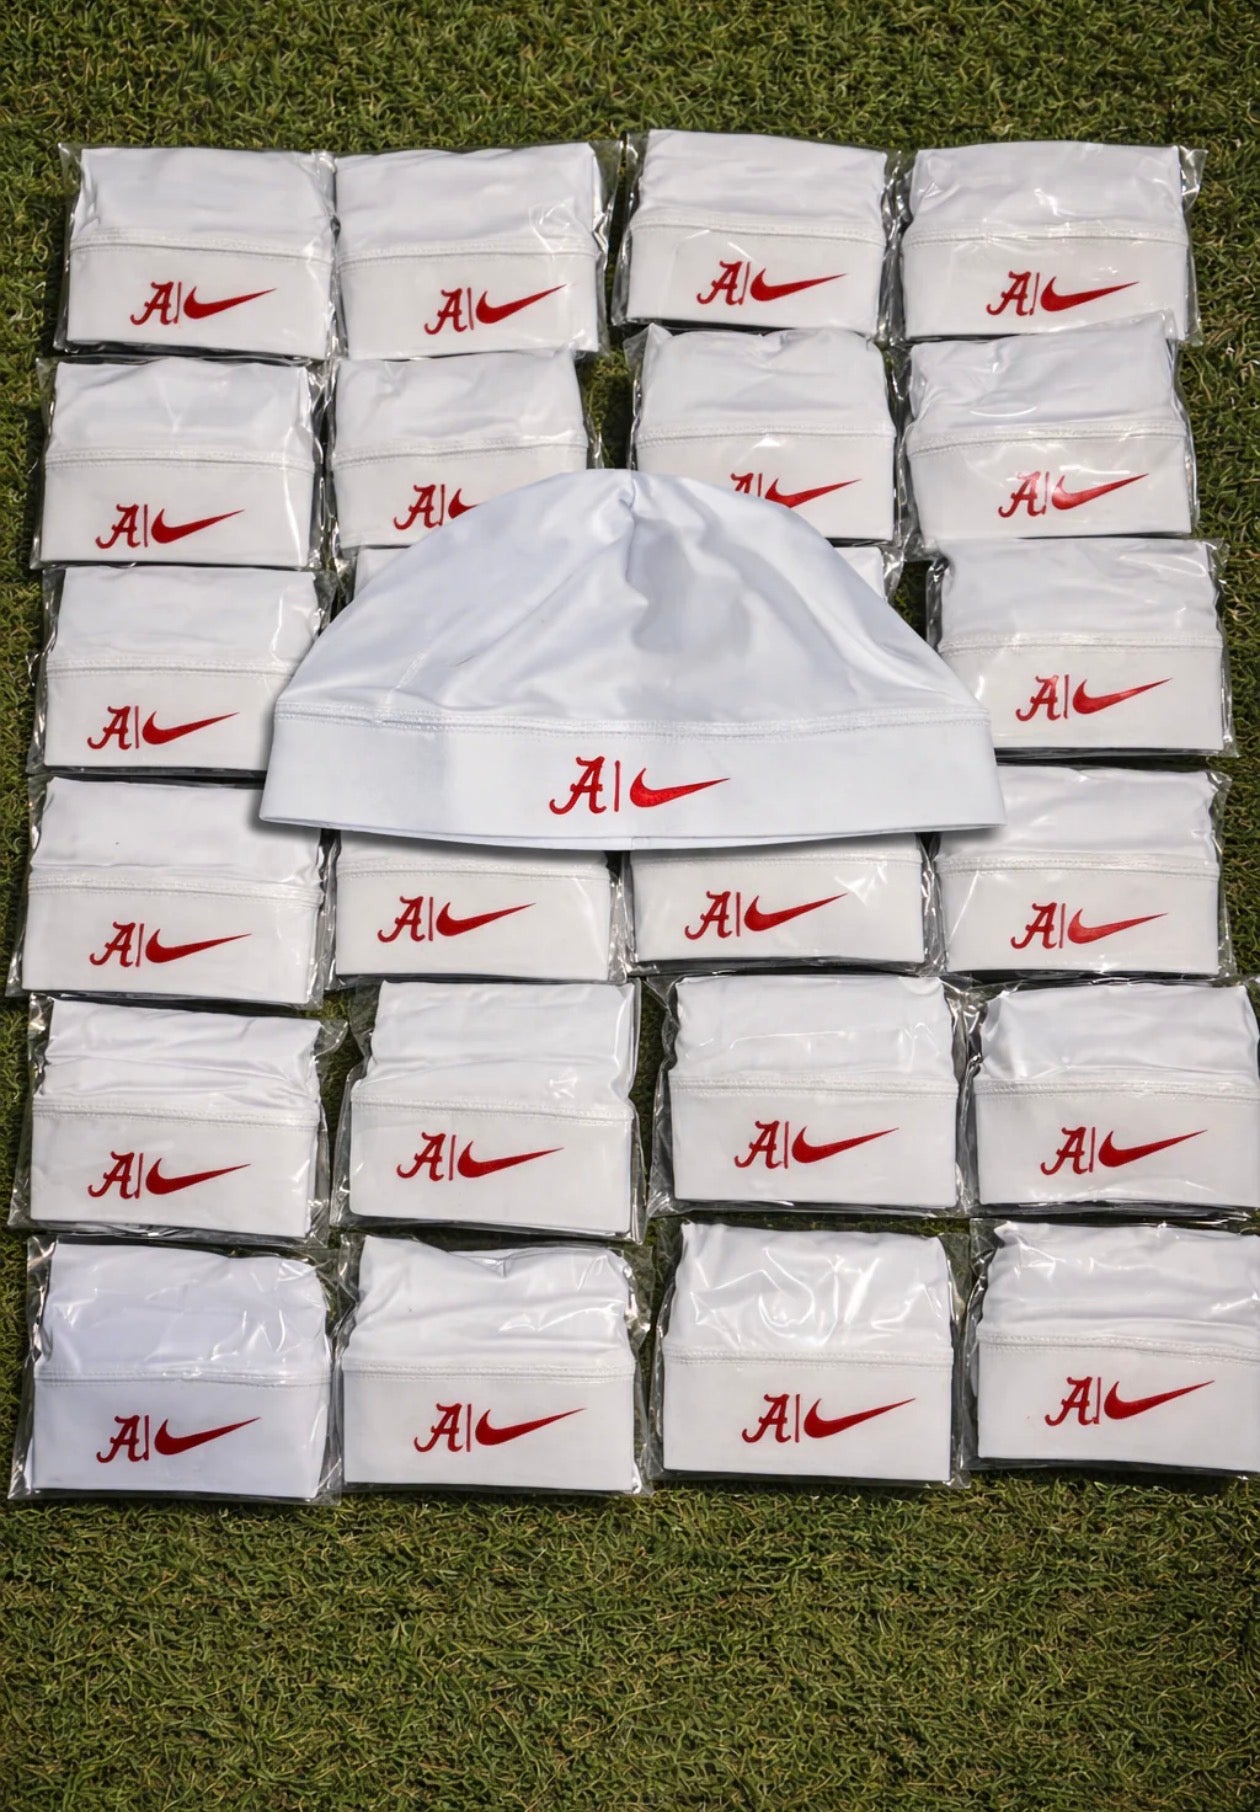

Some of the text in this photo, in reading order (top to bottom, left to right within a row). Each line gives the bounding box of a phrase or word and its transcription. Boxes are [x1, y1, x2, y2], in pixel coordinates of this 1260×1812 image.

[130, 281, 176, 327] A
[698, 260, 743, 306] A
[986, 272, 1034, 316] A
[425, 289, 466, 335] A
[394, 484, 441, 530] A
[999, 472, 1046, 518] A
[96, 505, 139, 549] A
[1016, 675, 1061, 722] A
[87, 705, 132, 750] A
[549, 756, 606, 815] A
[378, 896, 424, 943] A
[685, 891, 731, 940] A
[1011, 902, 1057, 949] A
[90, 923, 136, 967] A
[397, 1133, 446, 1181] A
[734, 1120, 782, 1170] A
[1041, 1126, 1091, 1176] A
[89, 1152, 134, 1199] A
[742, 1394, 790, 1443] A
[1045, 1376, 1097, 1426] A
[97, 1415, 147, 1463] A
[414, 1403, 462, 1452] A
